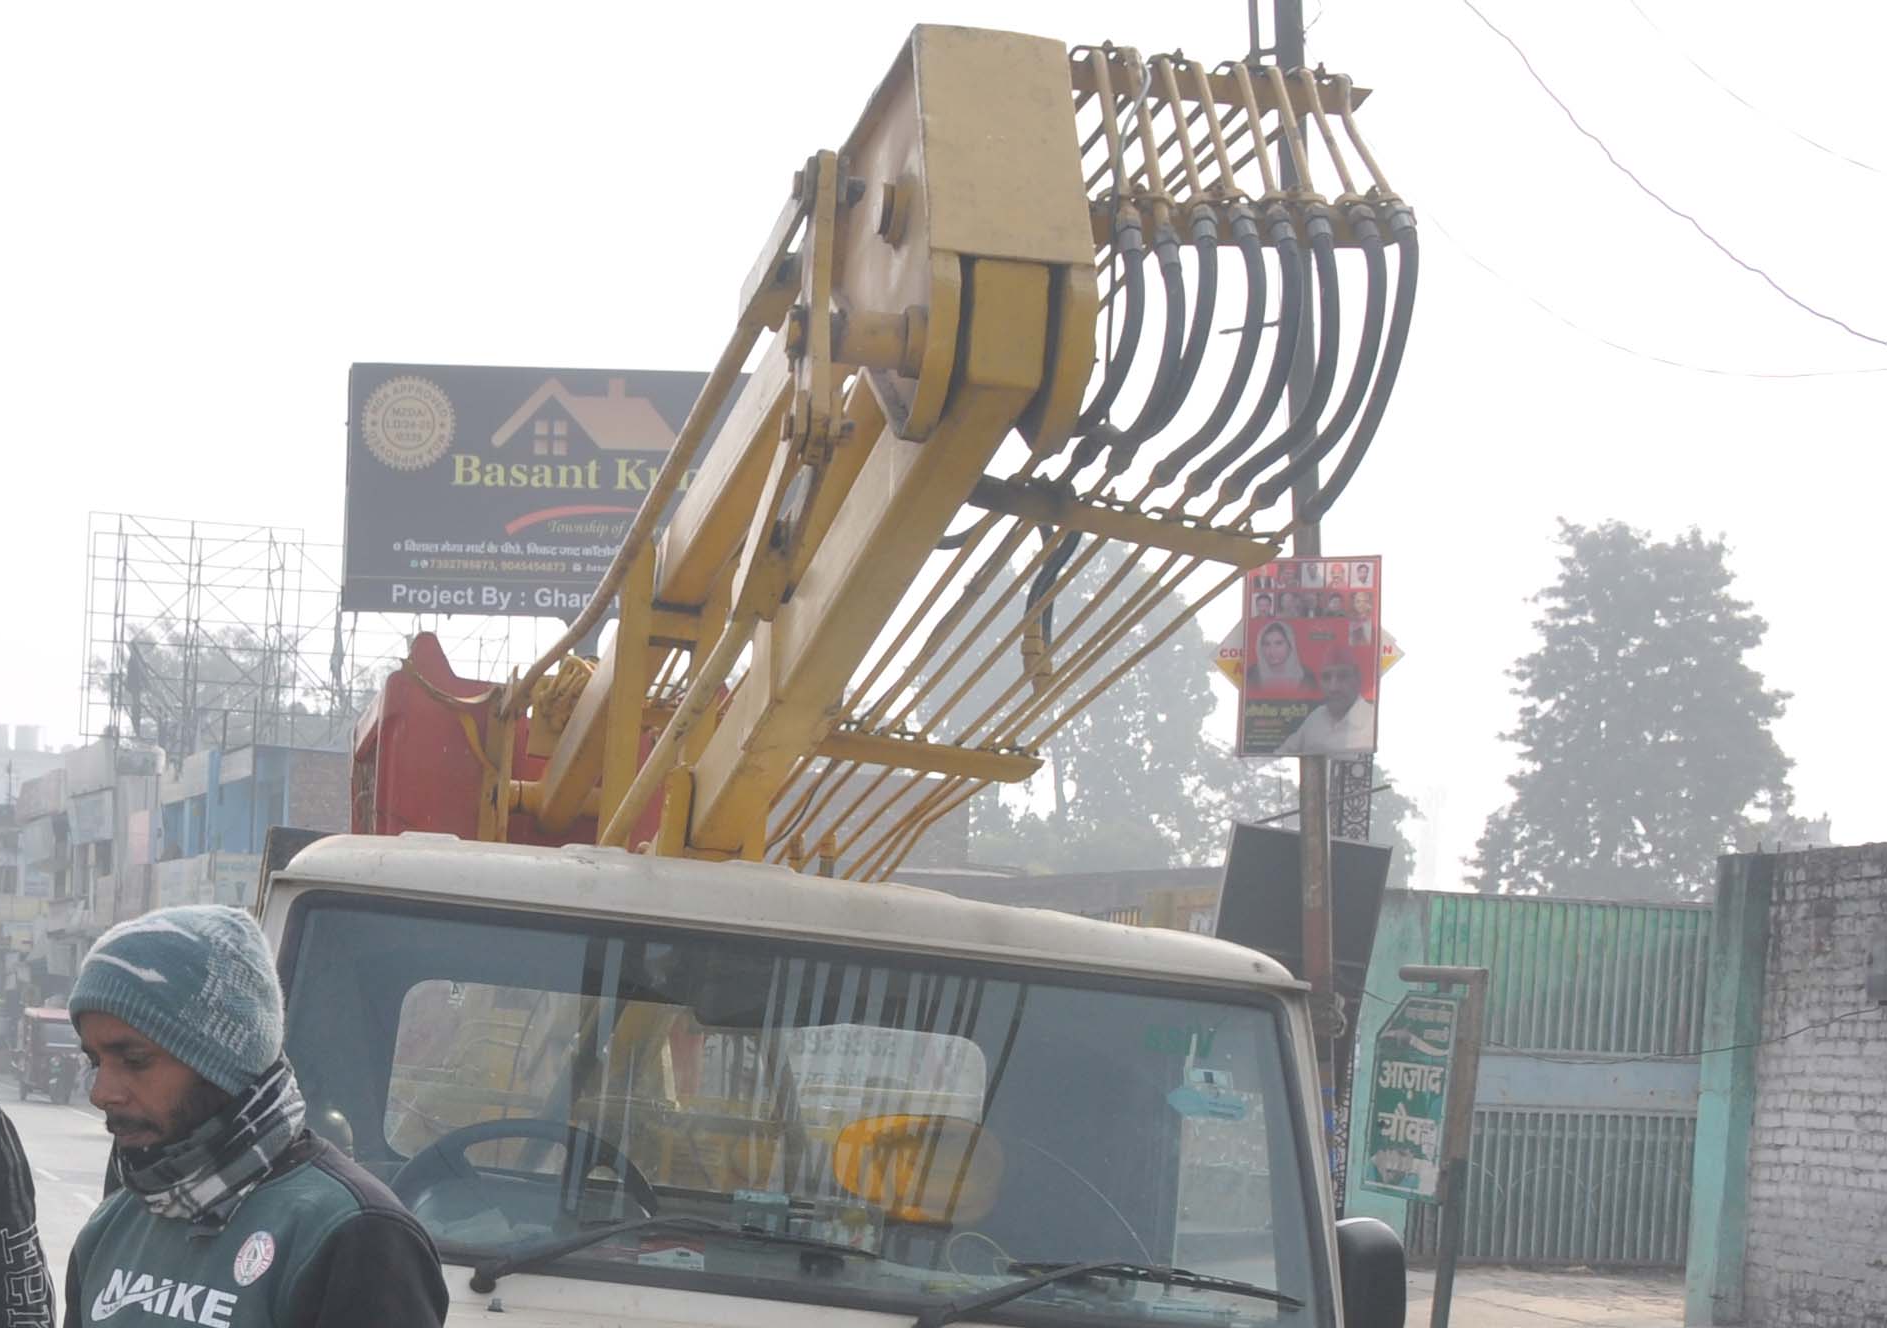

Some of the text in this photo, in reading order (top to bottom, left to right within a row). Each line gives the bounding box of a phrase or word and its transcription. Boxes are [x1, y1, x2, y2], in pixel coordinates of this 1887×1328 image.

[451, 453, 601, 489] Basant
[547, 519, 610, 538] Township
[611, 519, 626, 538] of
[391, 583, 474, 607] Project
[481, 585, 512, 610] By
[1377, 1060, 1445, 1100] आज़ाद
